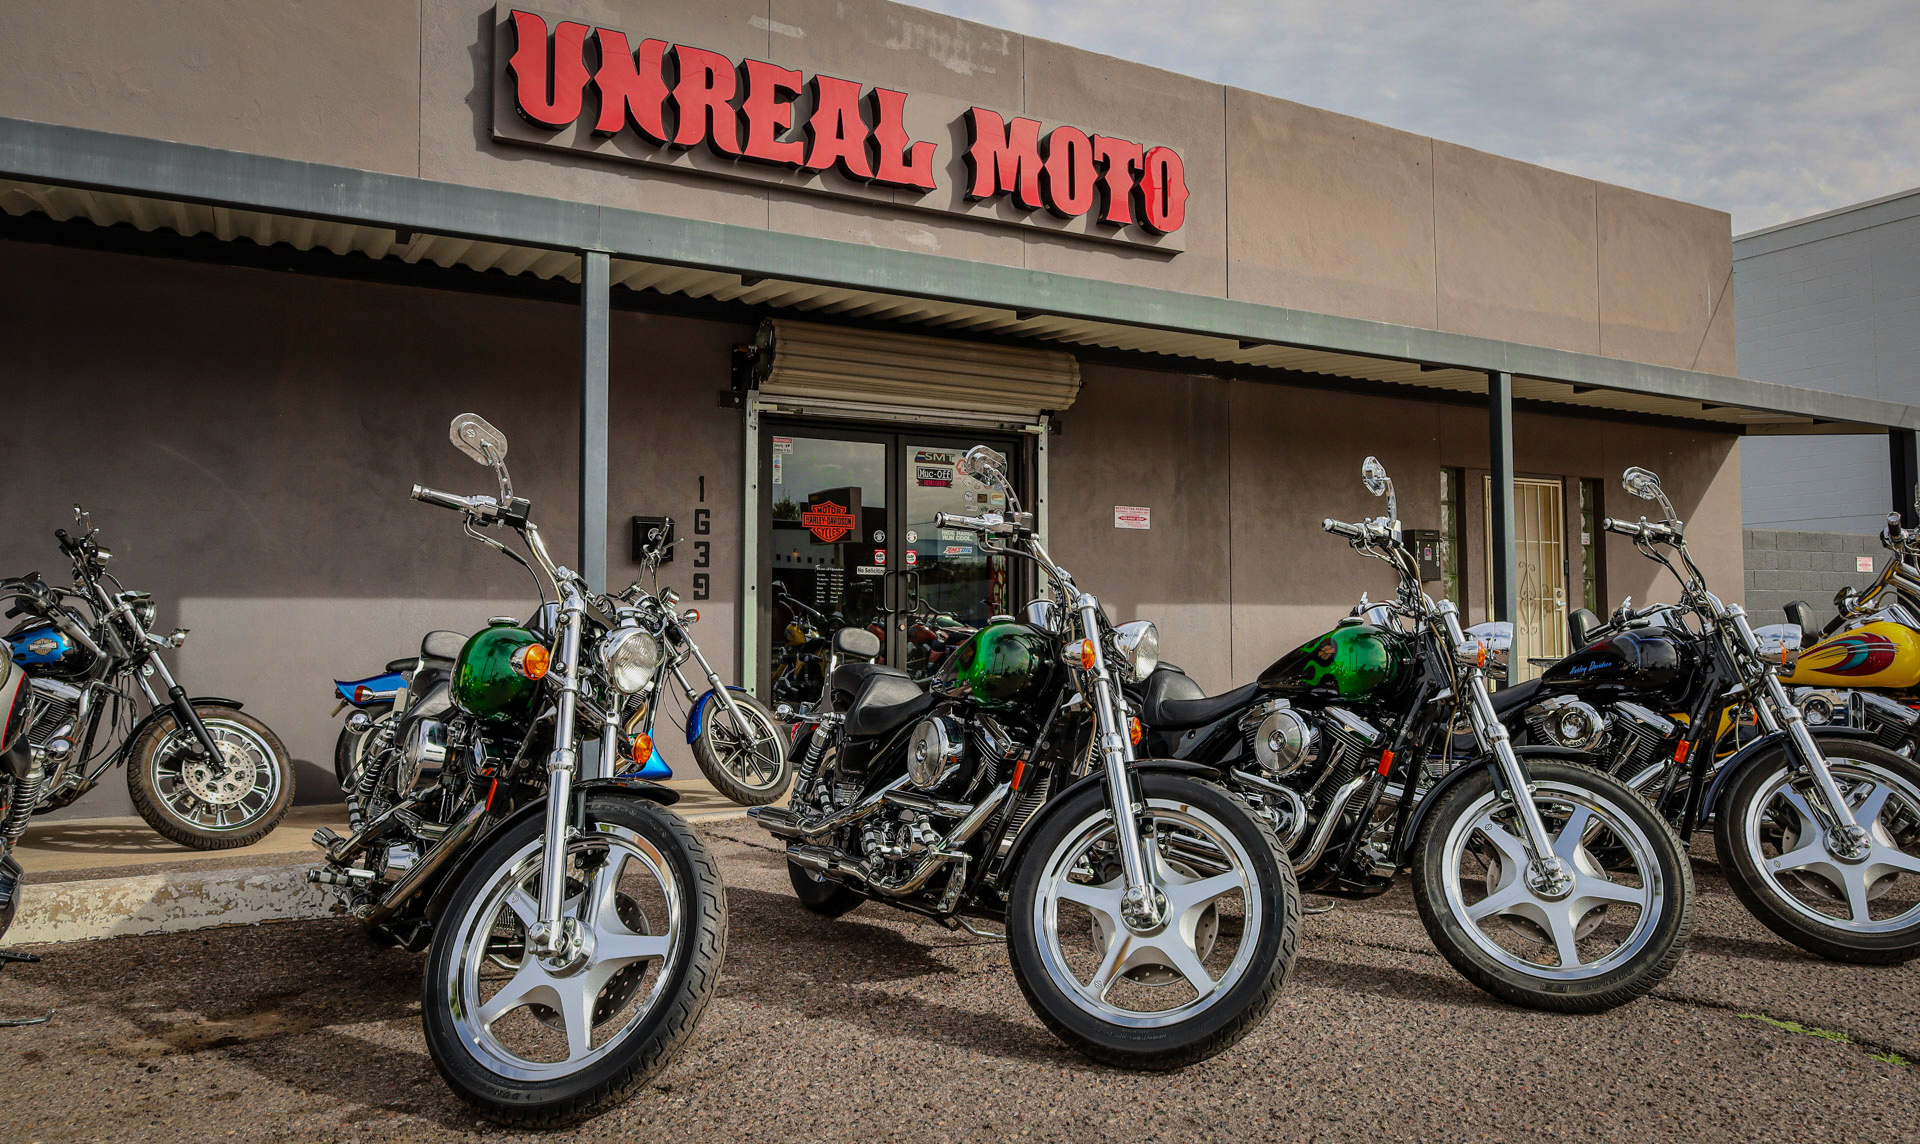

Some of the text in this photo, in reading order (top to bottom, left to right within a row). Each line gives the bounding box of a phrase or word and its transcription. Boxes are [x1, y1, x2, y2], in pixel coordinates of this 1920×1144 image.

[509, 9, 1190, 236] UNREAL MOTO
[924, 452, 955, 462] SMT
[919, 469, 951, 480] Muc-Off
[815, 506, 842, 514] MOTOR
[805, 515, 852, 526] HARLEY-DAVIDSON
[816, 527, 842, 538] CYCLES
[1569, 661, 1612, 676] Harley Davidson
